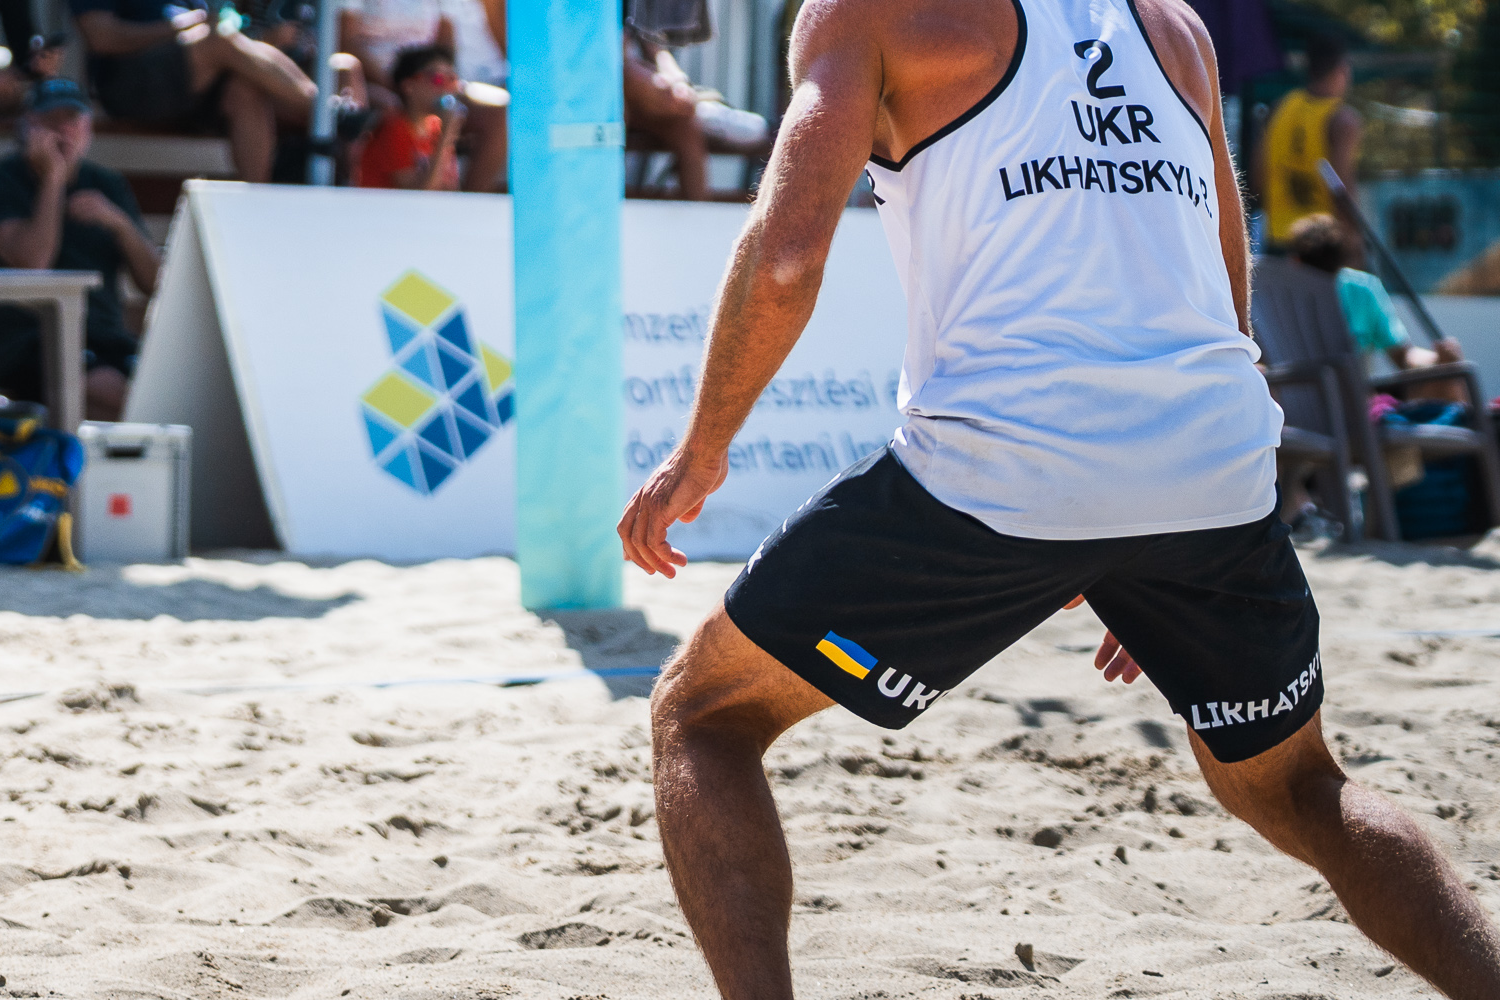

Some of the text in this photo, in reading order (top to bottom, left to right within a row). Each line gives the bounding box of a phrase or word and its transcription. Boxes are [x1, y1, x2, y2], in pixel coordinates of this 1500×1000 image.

[1074, 39, 1127, 100] 2
[1071, 100, 1162, 146] UKR
[877, 666, 946, 710] UK
[1191, 652, 1320, 730] LIKHATSK
